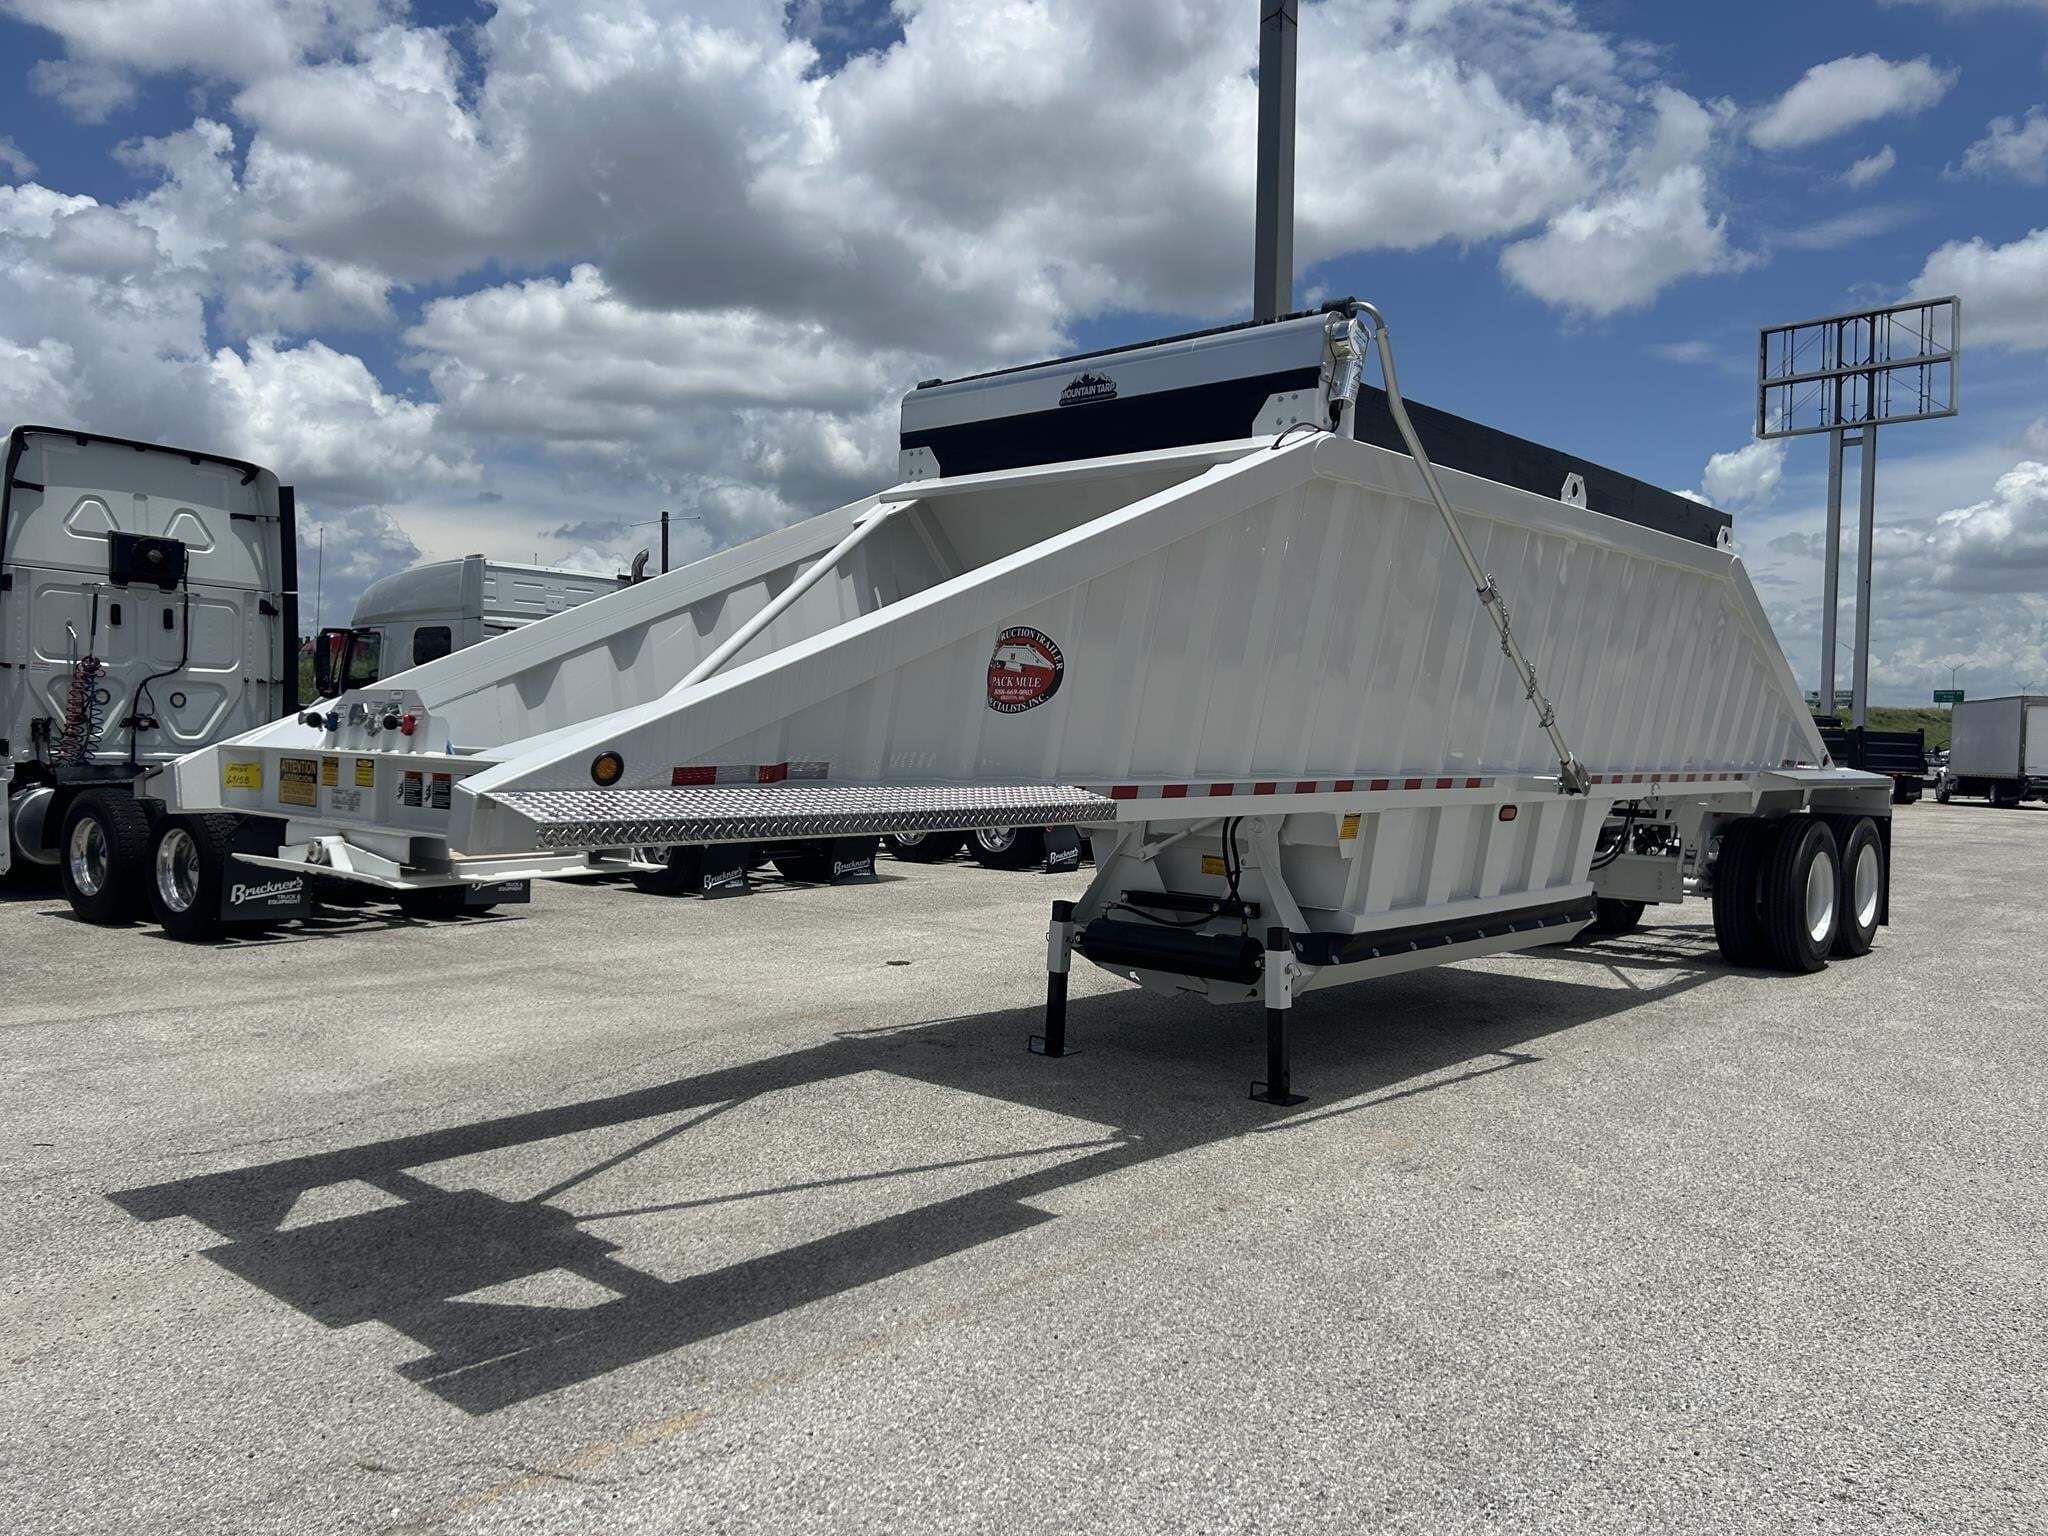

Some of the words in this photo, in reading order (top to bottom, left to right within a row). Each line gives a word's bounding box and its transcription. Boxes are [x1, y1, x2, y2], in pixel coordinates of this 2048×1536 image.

[1061, 386, 1096, 399] MOUNTAIN
[1097, 382, 1116, 393] TARP
[1036, 633, 1064, 670] TRAILER
[1015, 677, 1041, 688] MULE
[281, 760, 316, 774] ATTENTION
[230, 876, 303, 905] Bruckner's
